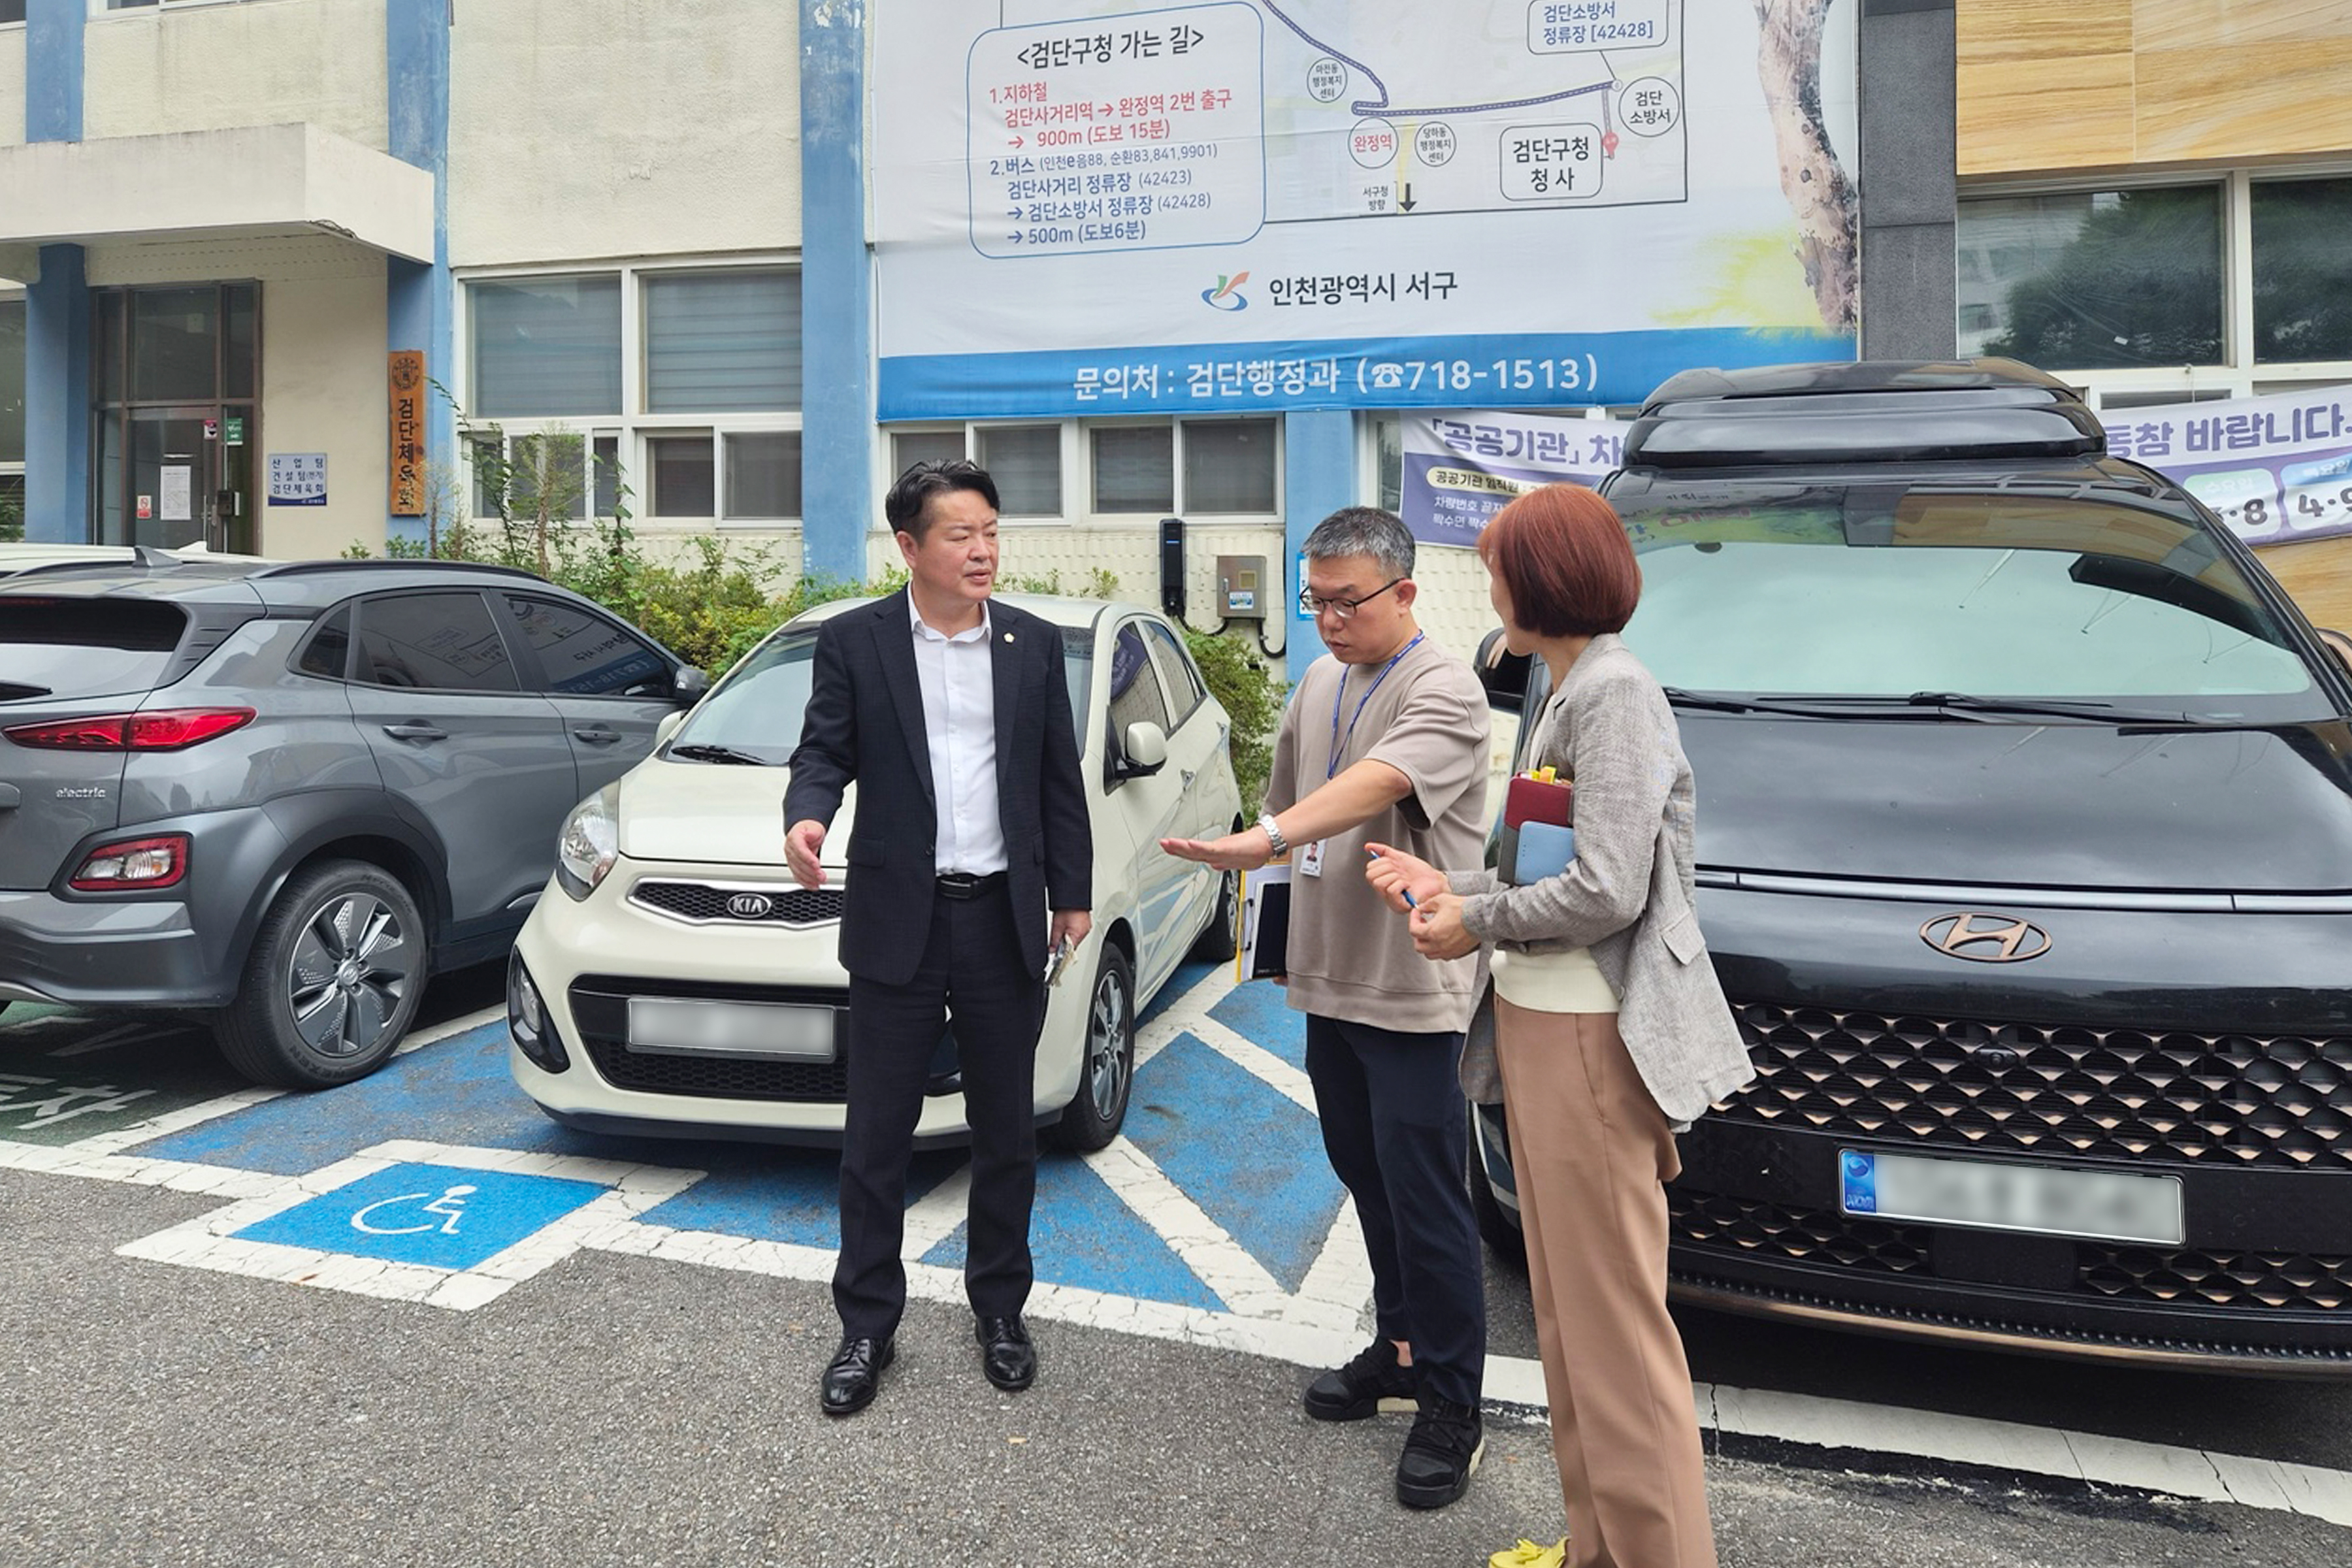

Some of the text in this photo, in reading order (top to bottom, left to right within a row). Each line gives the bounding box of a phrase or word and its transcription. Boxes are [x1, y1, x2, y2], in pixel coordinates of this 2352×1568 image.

[1544, 1, 1616, 23] 검단소방서
[1544, 20, 1654, 46] 정류장 [42428]
[1017, 25, 1204, 69] <검단구청 가는 길>
[1319, 88, 1335, 99] 센터
[1635, 90, 1663, 106] 검단
[1005, 89, 1232, 129] 검단사거리역 완정역 2번 출구
[1630, 108, 1671, 125] 소방서
[1037, 119, 1170, 147] 900m (도보 15분)
[1354, 134, 1392, 153] 완정역
[1428, 152, 1445, 163] 센터
[1512, 137, 1590, 163] 검단구청
[1008, 169, 1192, 200] 검단사거리 정류장 (42423)
[1028, 192, 1211, 222] 검단소방서 정류장 (42428)
[1028, 220, 1147, 244] 500m (도보6분)
[1269, 271, 1458, 306] 인천광역시 서구
[1186, 359, 1340, 397] 검단행정과
[1589, 434, 1625, 466] 차
[1435, 470, 1483, 489] 공공기관
[1434, 496, 1507, 514] 차량번호 끝자
[56, 787, 106, 798] electric
[732, 898, 762, 912] KIA
